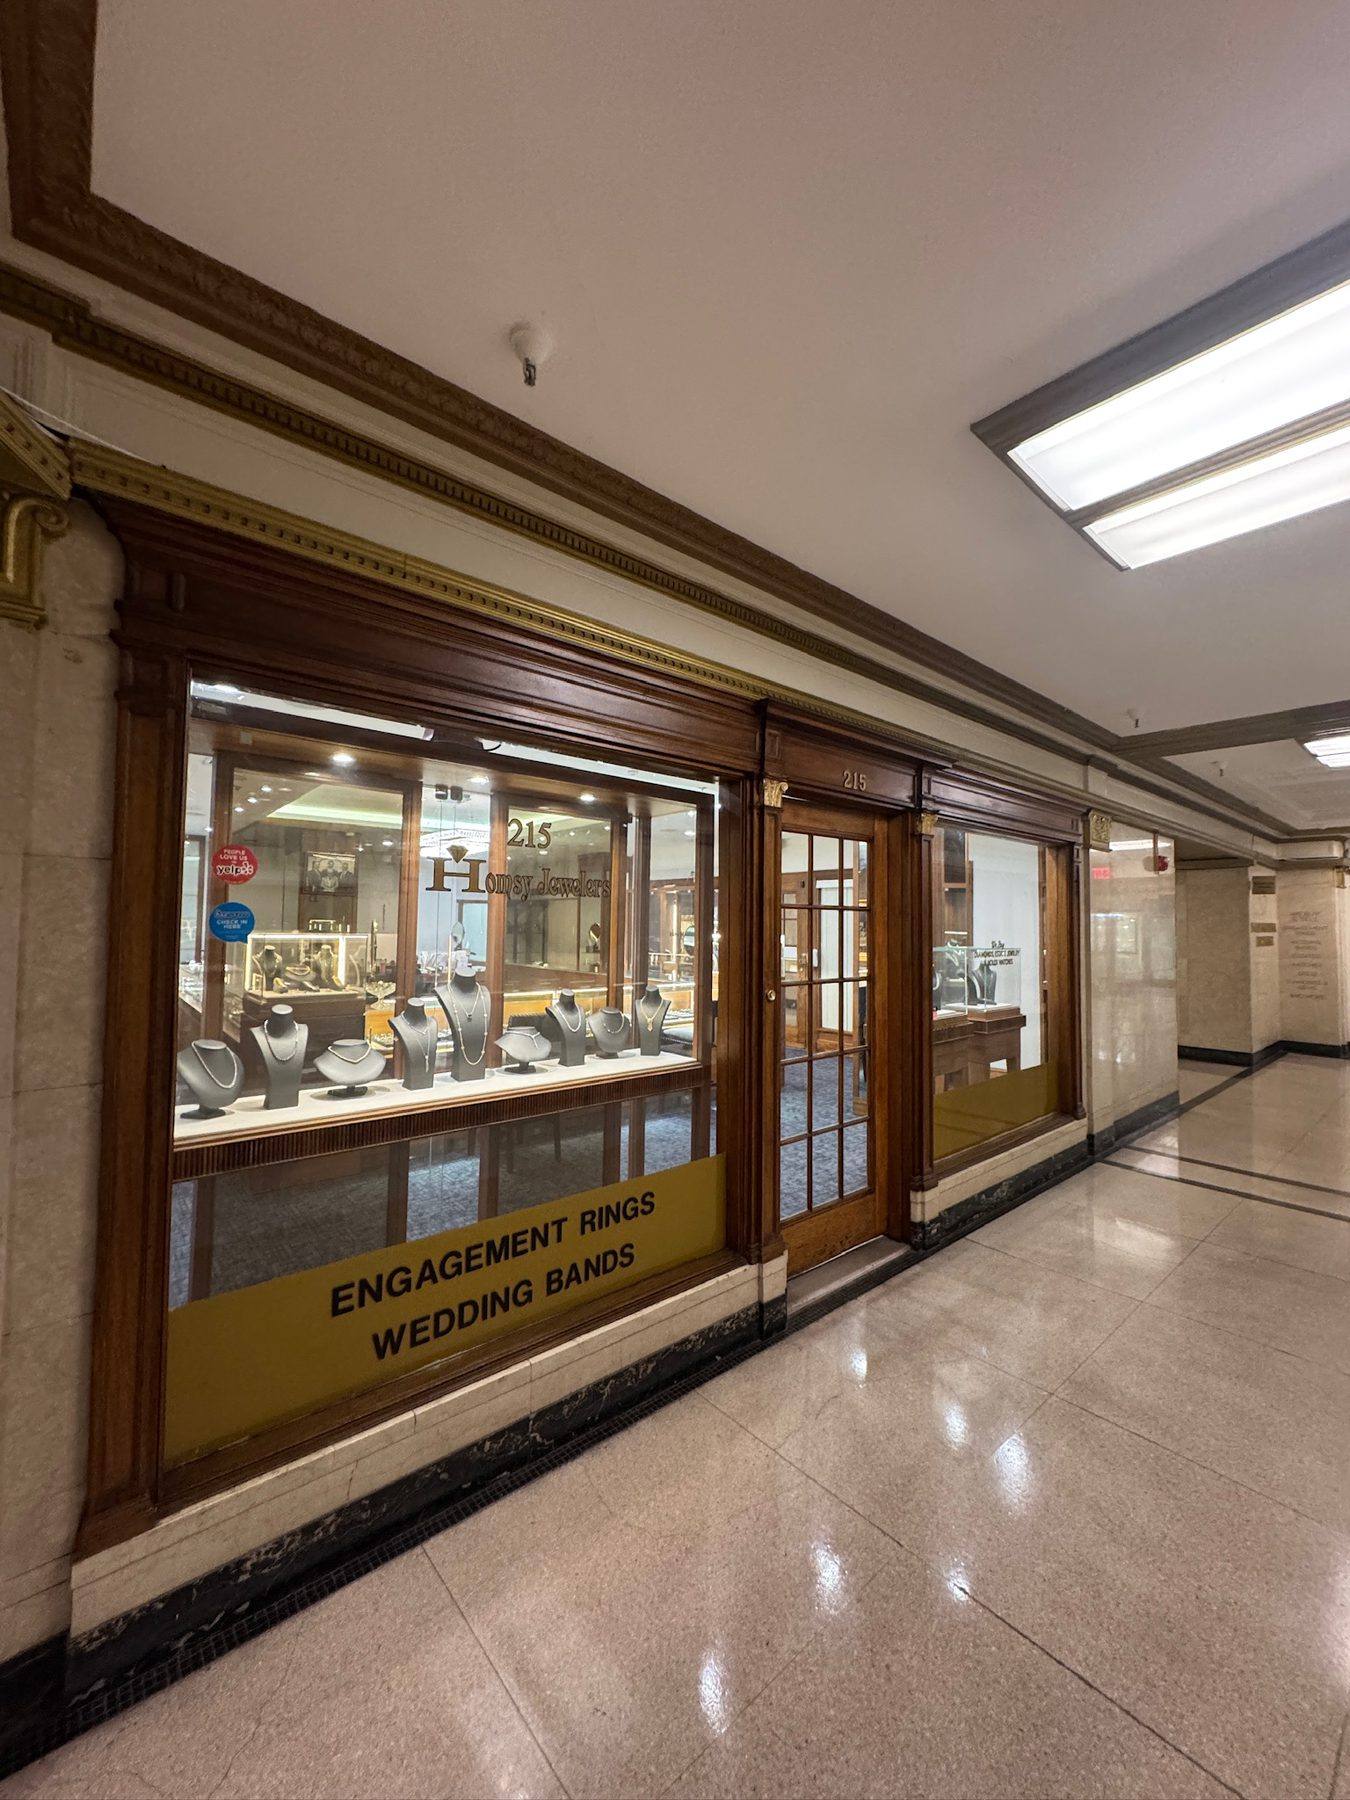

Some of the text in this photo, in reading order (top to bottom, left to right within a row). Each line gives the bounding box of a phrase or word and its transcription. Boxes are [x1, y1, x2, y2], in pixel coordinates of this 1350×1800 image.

[843, 770, 866, 791] 215
[507, 818, 552, 849] 215
[426, 857, 611, 901] Homsy Jewelers
[331, 1191, 656, 1318] ENGAGEMENT RINGS
[372, 1243, 635, 1360] WEDDING BANDS
